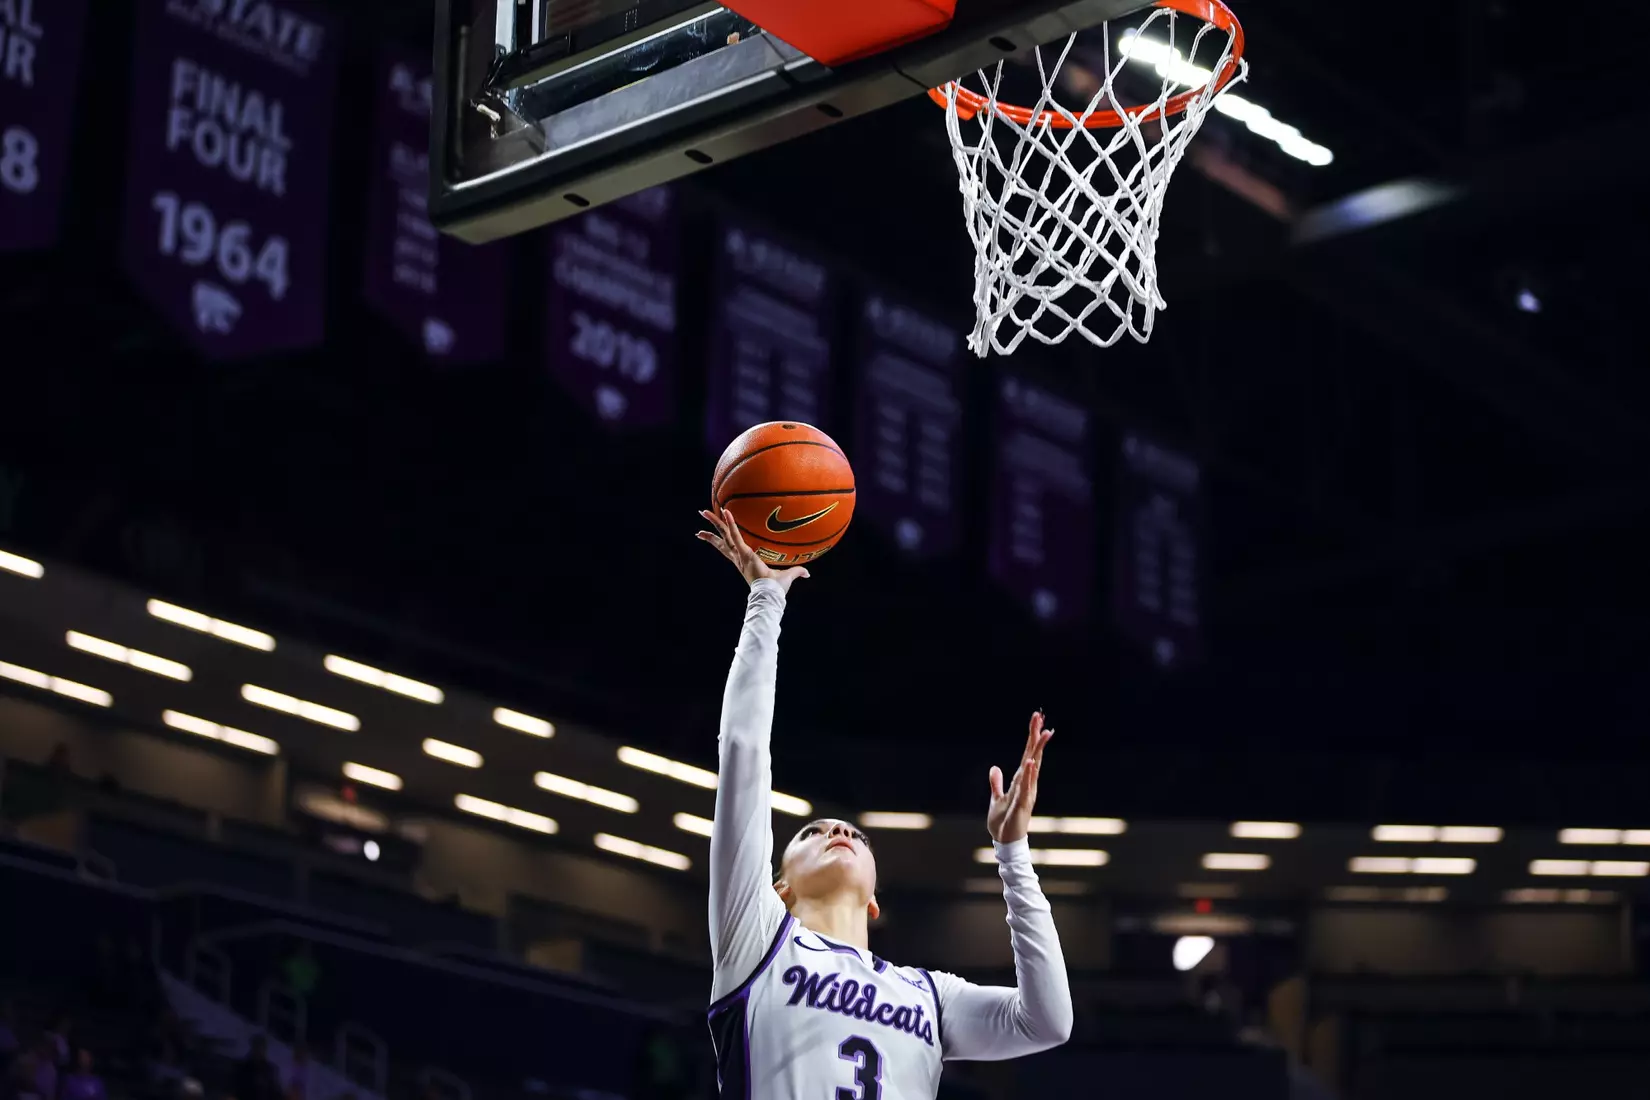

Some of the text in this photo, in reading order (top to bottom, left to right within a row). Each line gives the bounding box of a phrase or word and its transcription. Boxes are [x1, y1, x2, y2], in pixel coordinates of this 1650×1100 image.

[169, 55, 293, 151] FINAL
[0, 124, 40, 195] 8
[165, 104, 288, 198] FOUR
[151, 188, 291, 302] 1964
[781, 964, 935, 1048] Wildcats
[835, 1034, 883, 1100] 3
